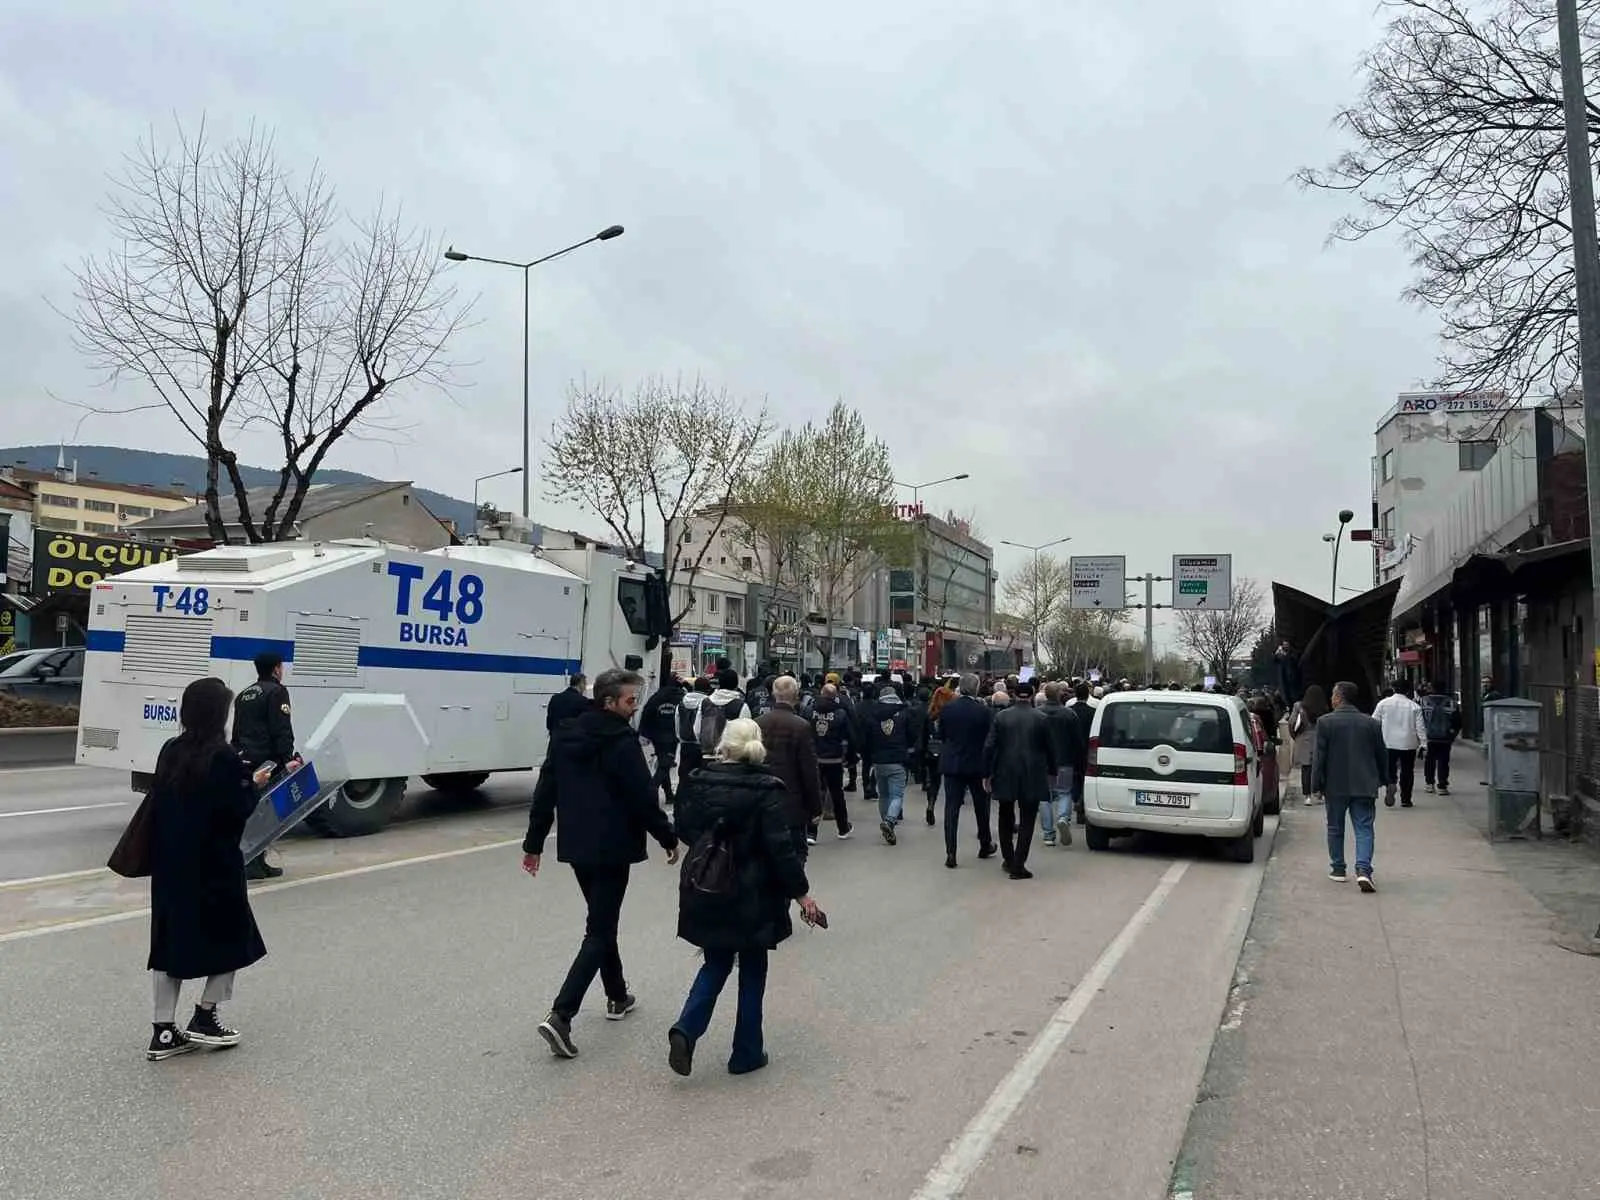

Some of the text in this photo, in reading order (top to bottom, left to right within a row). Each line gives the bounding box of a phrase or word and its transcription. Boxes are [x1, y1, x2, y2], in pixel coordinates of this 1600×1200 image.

[387, 561, 484, 625] T48
[400, 622, 468, 647] BURSA
[143, 703, 177, 722] BURSA
[1167, 795, 1187, 806] 7091
